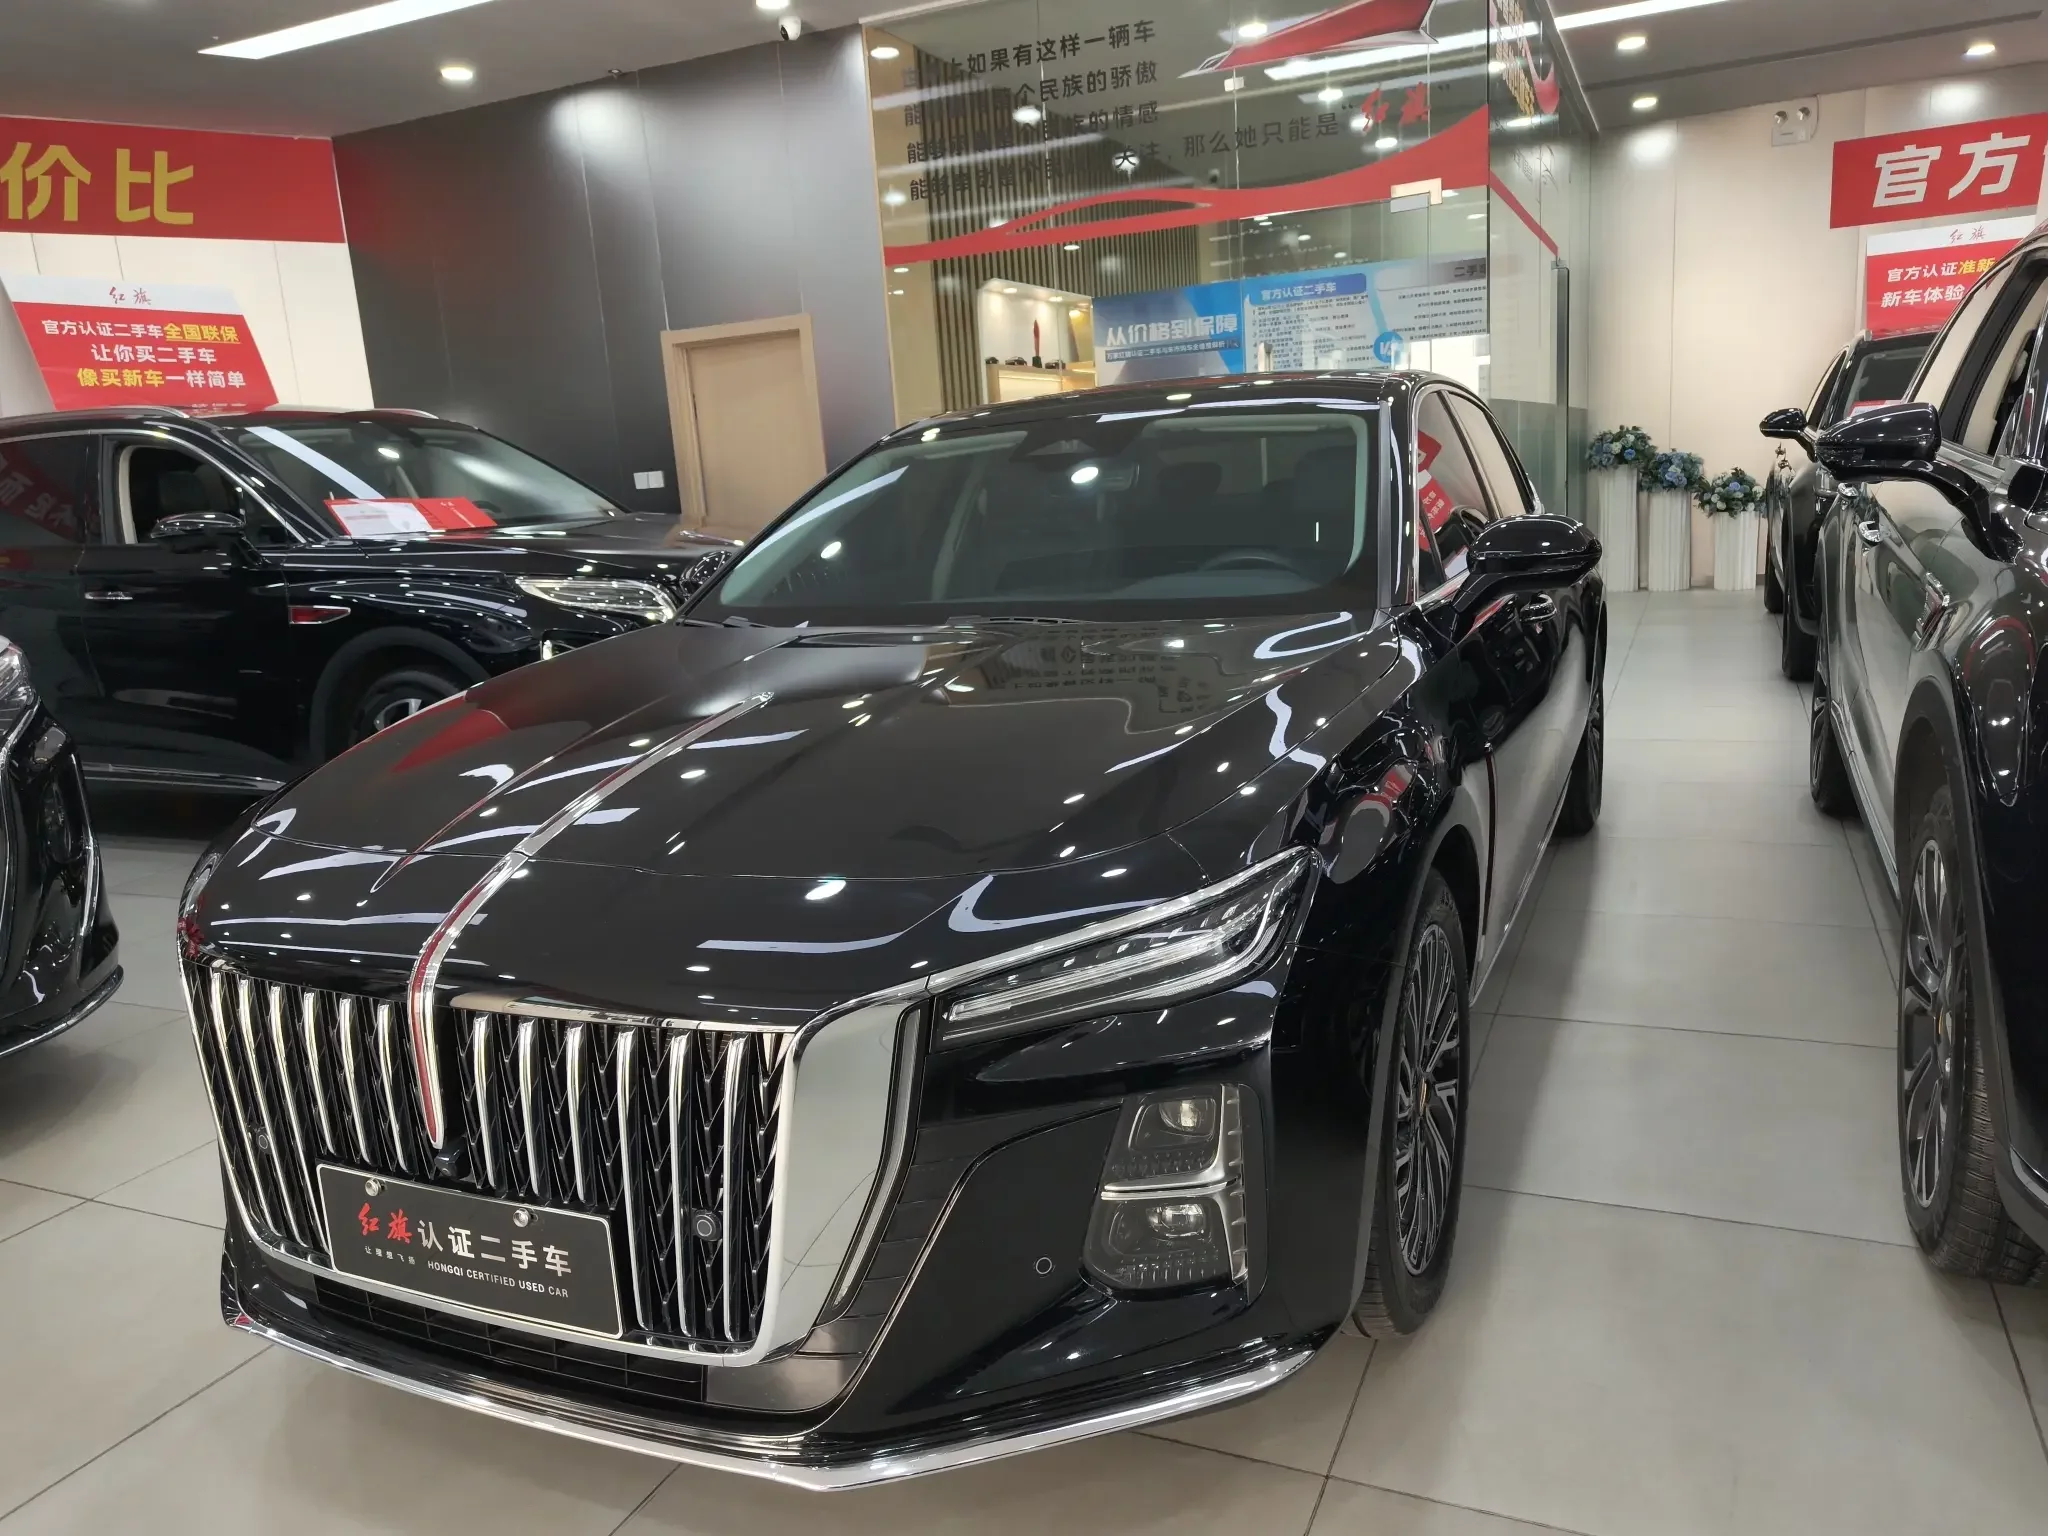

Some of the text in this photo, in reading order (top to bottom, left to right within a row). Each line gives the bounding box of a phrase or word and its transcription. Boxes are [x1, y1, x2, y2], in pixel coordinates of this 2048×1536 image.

[1872, 132, 2048, 208] 官方
[0, 142, 193, 225] 价比
[1949, 224, 1987, 244] 红旗
[1887, 258, 1996, 283] 官方认证准新
[109, 286, 152, 305] 红旗
[1261, 282, 1337, 301] 官方认证二手车
[1881, 284, 1966, 308] 新车体验
[42, 320, 240, 343] 官方认证二手车全国联保
[1106, 313, 1238, 346] 从价格到保障
[91, 344, 217, 364] 让你买二手车
[77, 368, 246, 389] 像买新车一样简单
[427, 1260, 569, 1298] HONGQI CERTIFIED USED CAR
